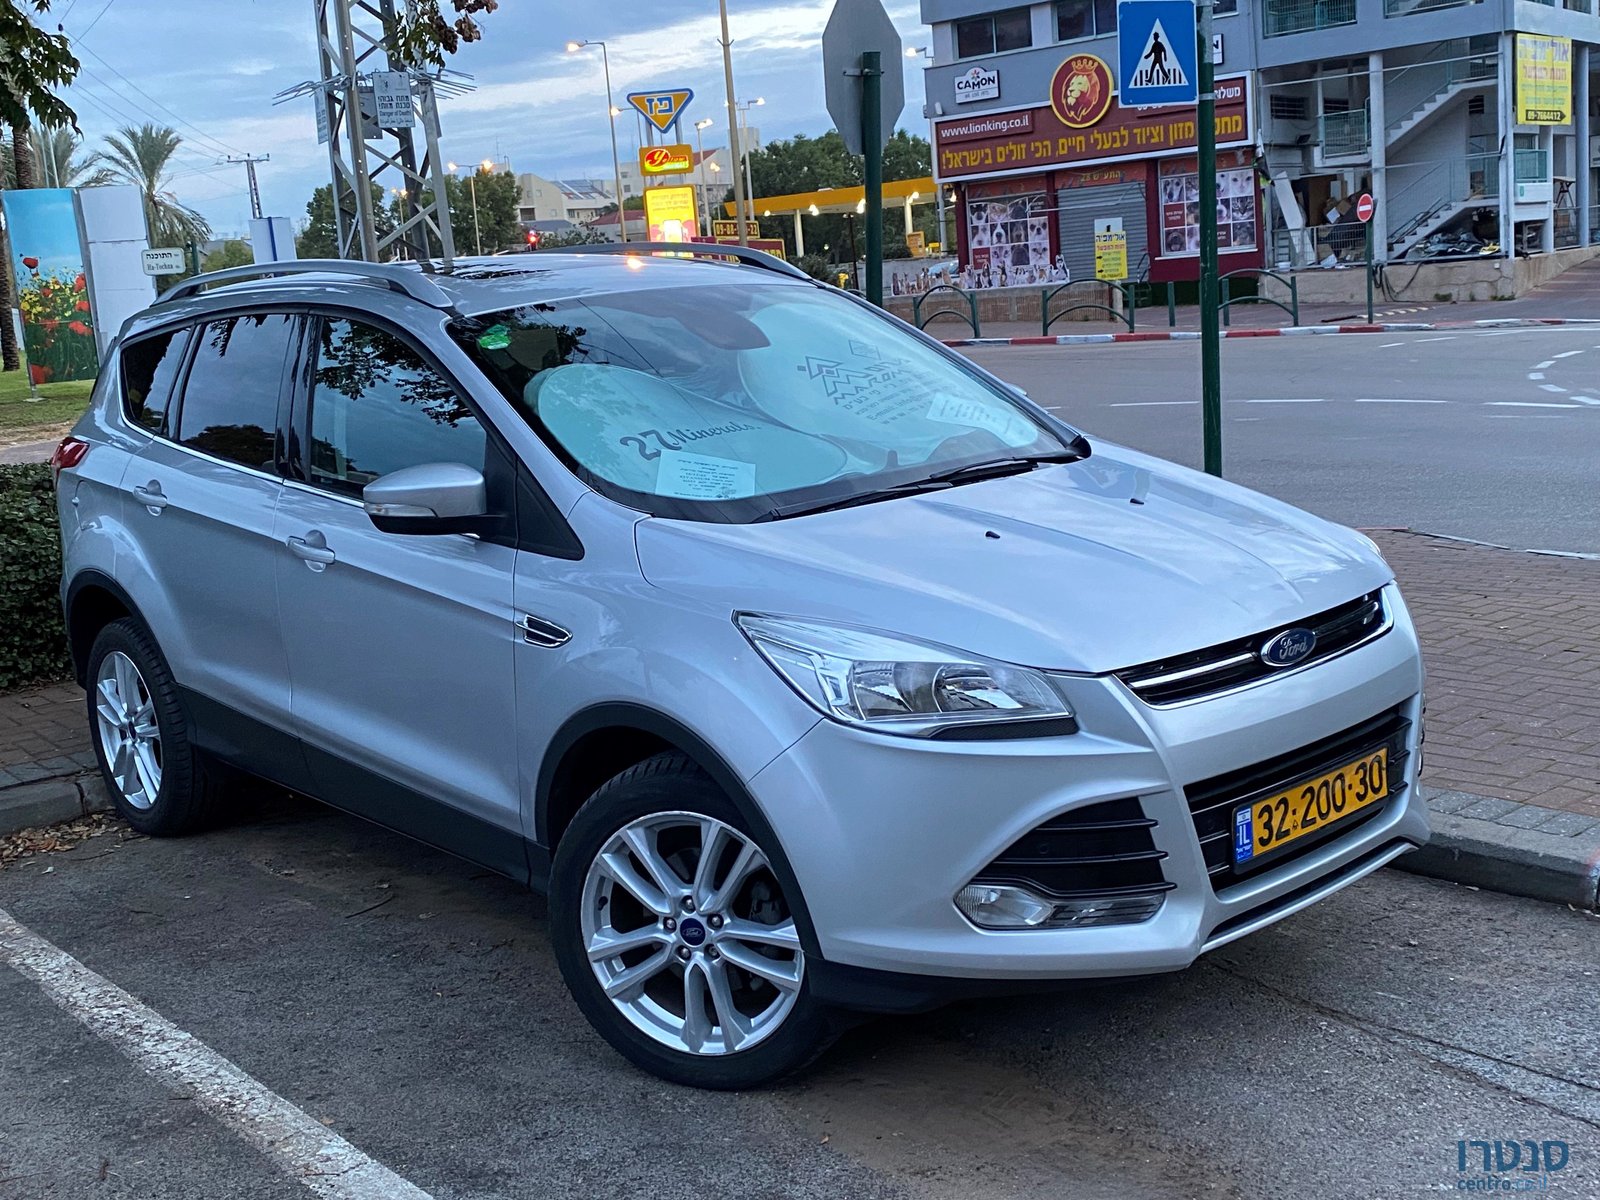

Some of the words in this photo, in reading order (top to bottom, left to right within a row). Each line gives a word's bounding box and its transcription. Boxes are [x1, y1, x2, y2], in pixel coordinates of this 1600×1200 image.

[957, 75, 996, 90] CAMON
[645, 96, 675, 115] פז
[941, 115, 1030, 138] www.lionking.co.il
[1133, 125, 1164, 145] וציוד
[1168, 121, 1195, 145] מזון
[1056, 136, 1086, 157] חיים,
[1090, 126, 1129, 150] לבעלי
[941, 147, 993, 169] בישראל!
[996, 141, 1027, 163] זולים
[1031, 140, 1052, 158] הכי
[146, 252, 173, 260] התוכנה
[619, 429, 683, 461] 27
[1279, 636, 1309, 660] Ford
[1239, 827, 1250, 845] IL
